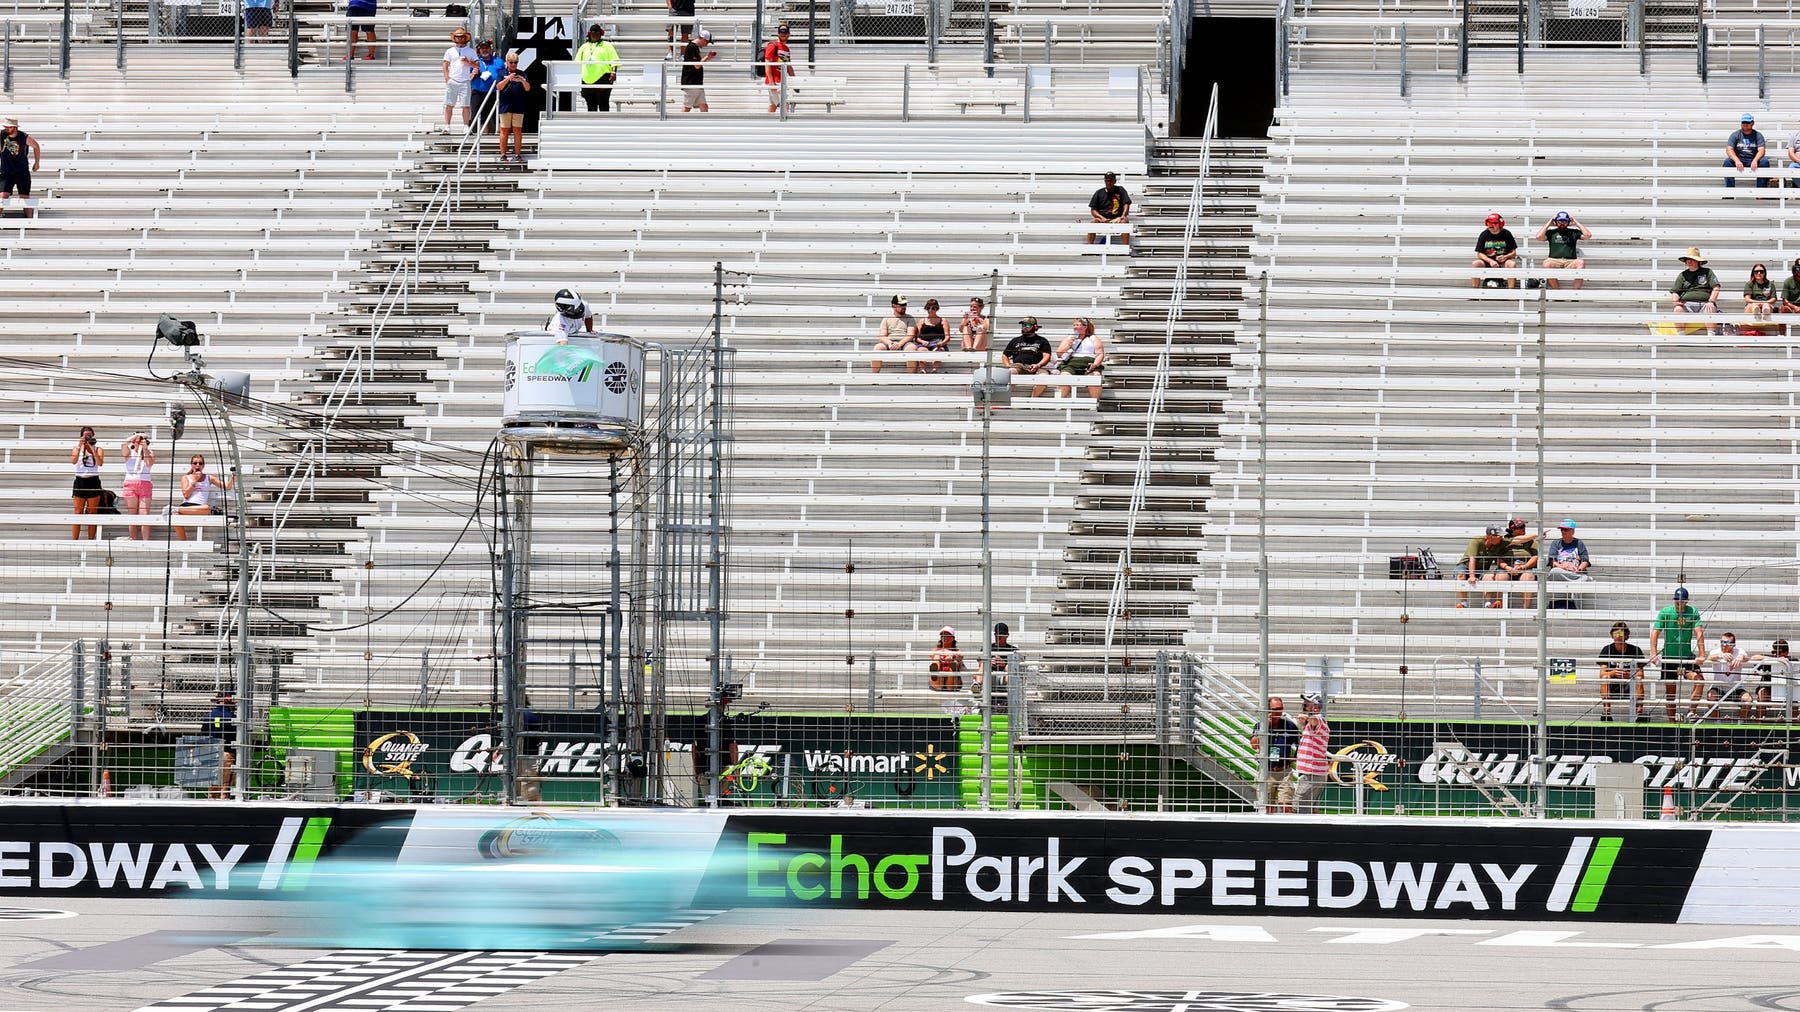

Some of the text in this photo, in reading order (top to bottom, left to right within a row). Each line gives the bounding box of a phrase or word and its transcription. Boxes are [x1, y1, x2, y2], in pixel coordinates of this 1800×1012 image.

[1553, 663, 1572, 671] 145
[381, 741, 429, 752] QUAKER
[385, 752, 420, 761] STATE
[804, 750, 909, 773] Walmart
[1348, 751, 1397, 763] QUAKER
[1418, 750, 1612, 785] QUAKER
[748, 826, 1538, 911] EchoPark SPEEDWAY
